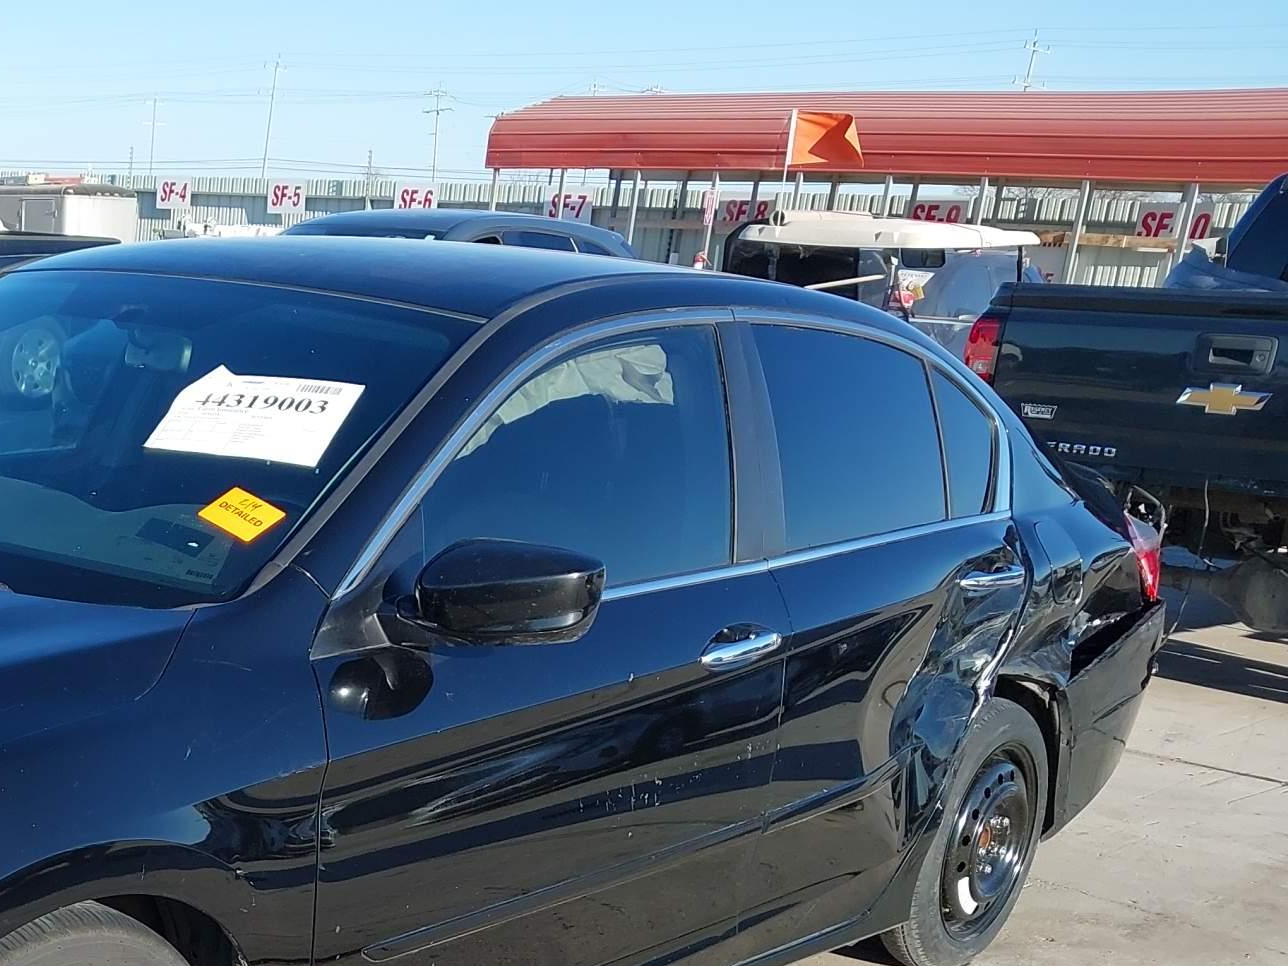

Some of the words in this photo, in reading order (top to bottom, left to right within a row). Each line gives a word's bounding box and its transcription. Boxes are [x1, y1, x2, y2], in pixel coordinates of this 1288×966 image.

[160, 181, 187, 203] SF-4
[271, 184, 301, 207] SF-5
[398, 188, 434, 208] SF-6
[196, 392, 329, 415] 44319003
[218, 501, 264, 527] DETAILED
